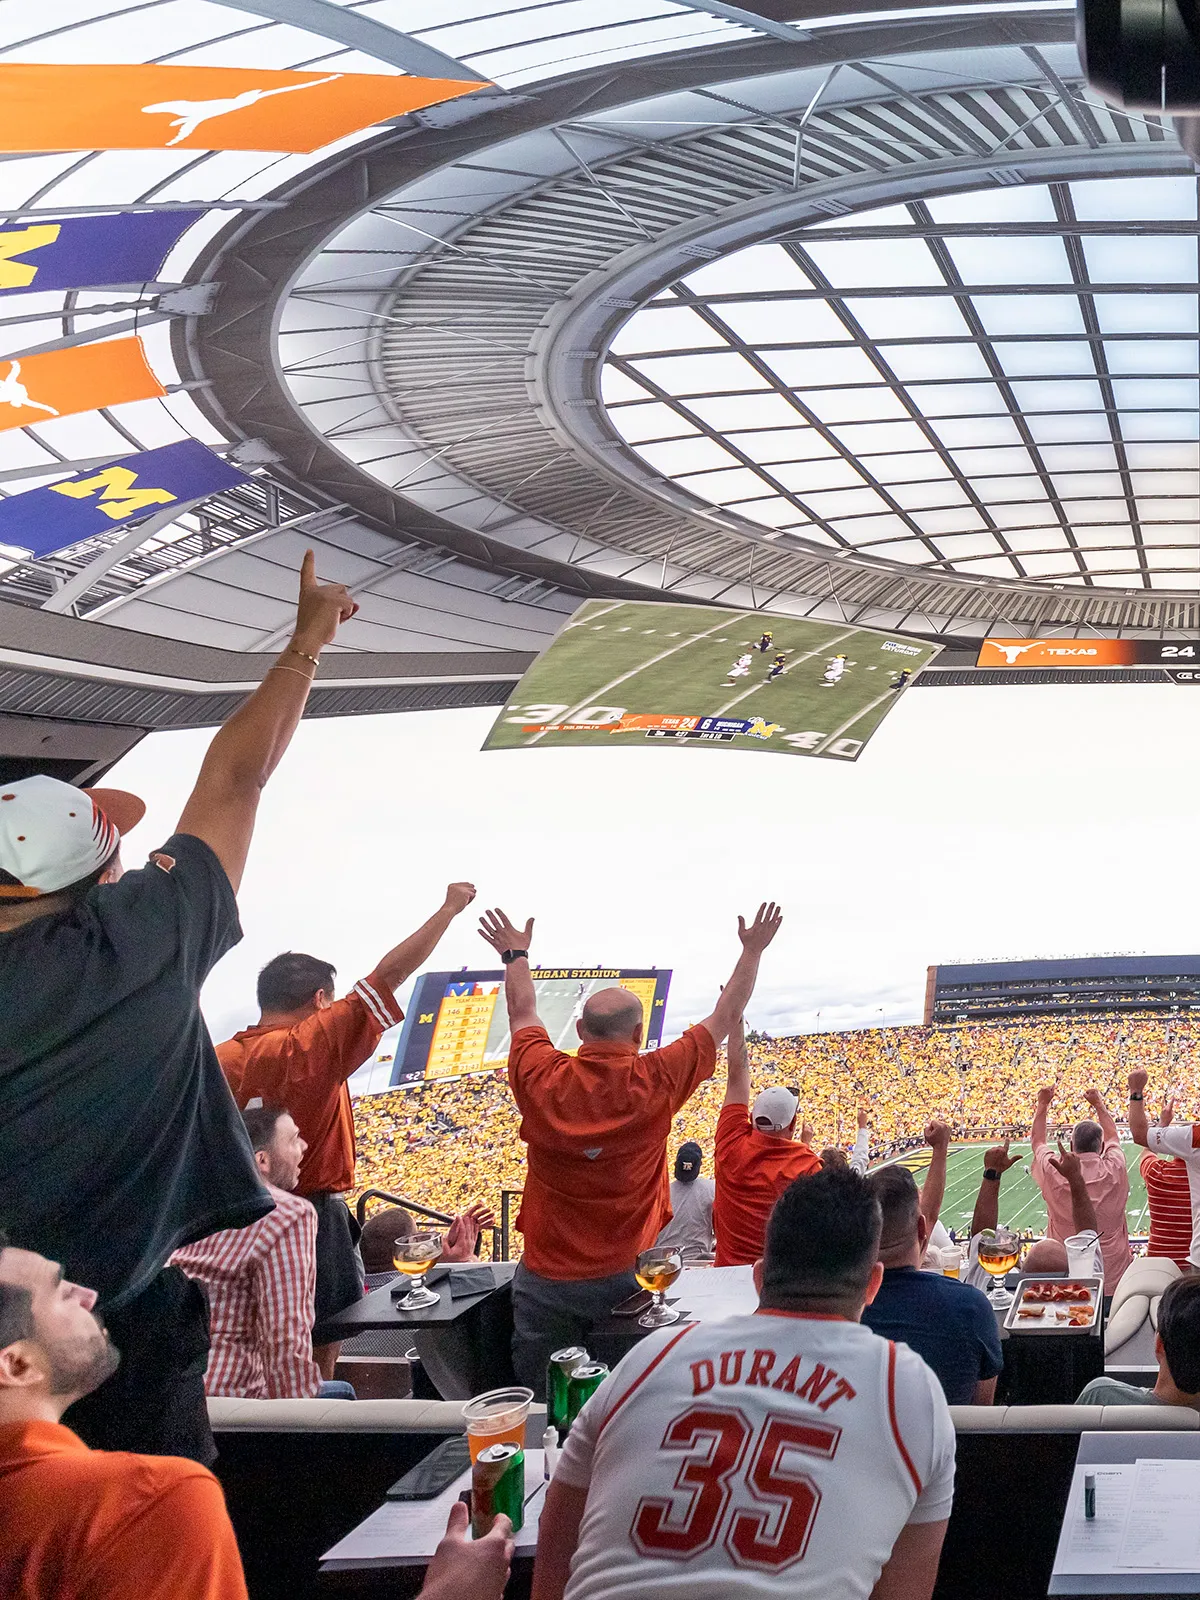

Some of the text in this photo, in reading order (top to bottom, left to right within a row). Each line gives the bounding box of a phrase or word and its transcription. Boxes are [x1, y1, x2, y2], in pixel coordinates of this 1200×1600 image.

[48, 466, 178, 520] M
[1160, 646, 1195, 657] 24
[679, 717, 698, 729] 24
[701, 718, 713, 730] 6
[531, 969, 620, 979] HIGAN STADIUM
[418, 1012, 434, 1024] M
[689, 1348, 857, 1413] DURANT
[629, 1402, 843, 1576] 35
